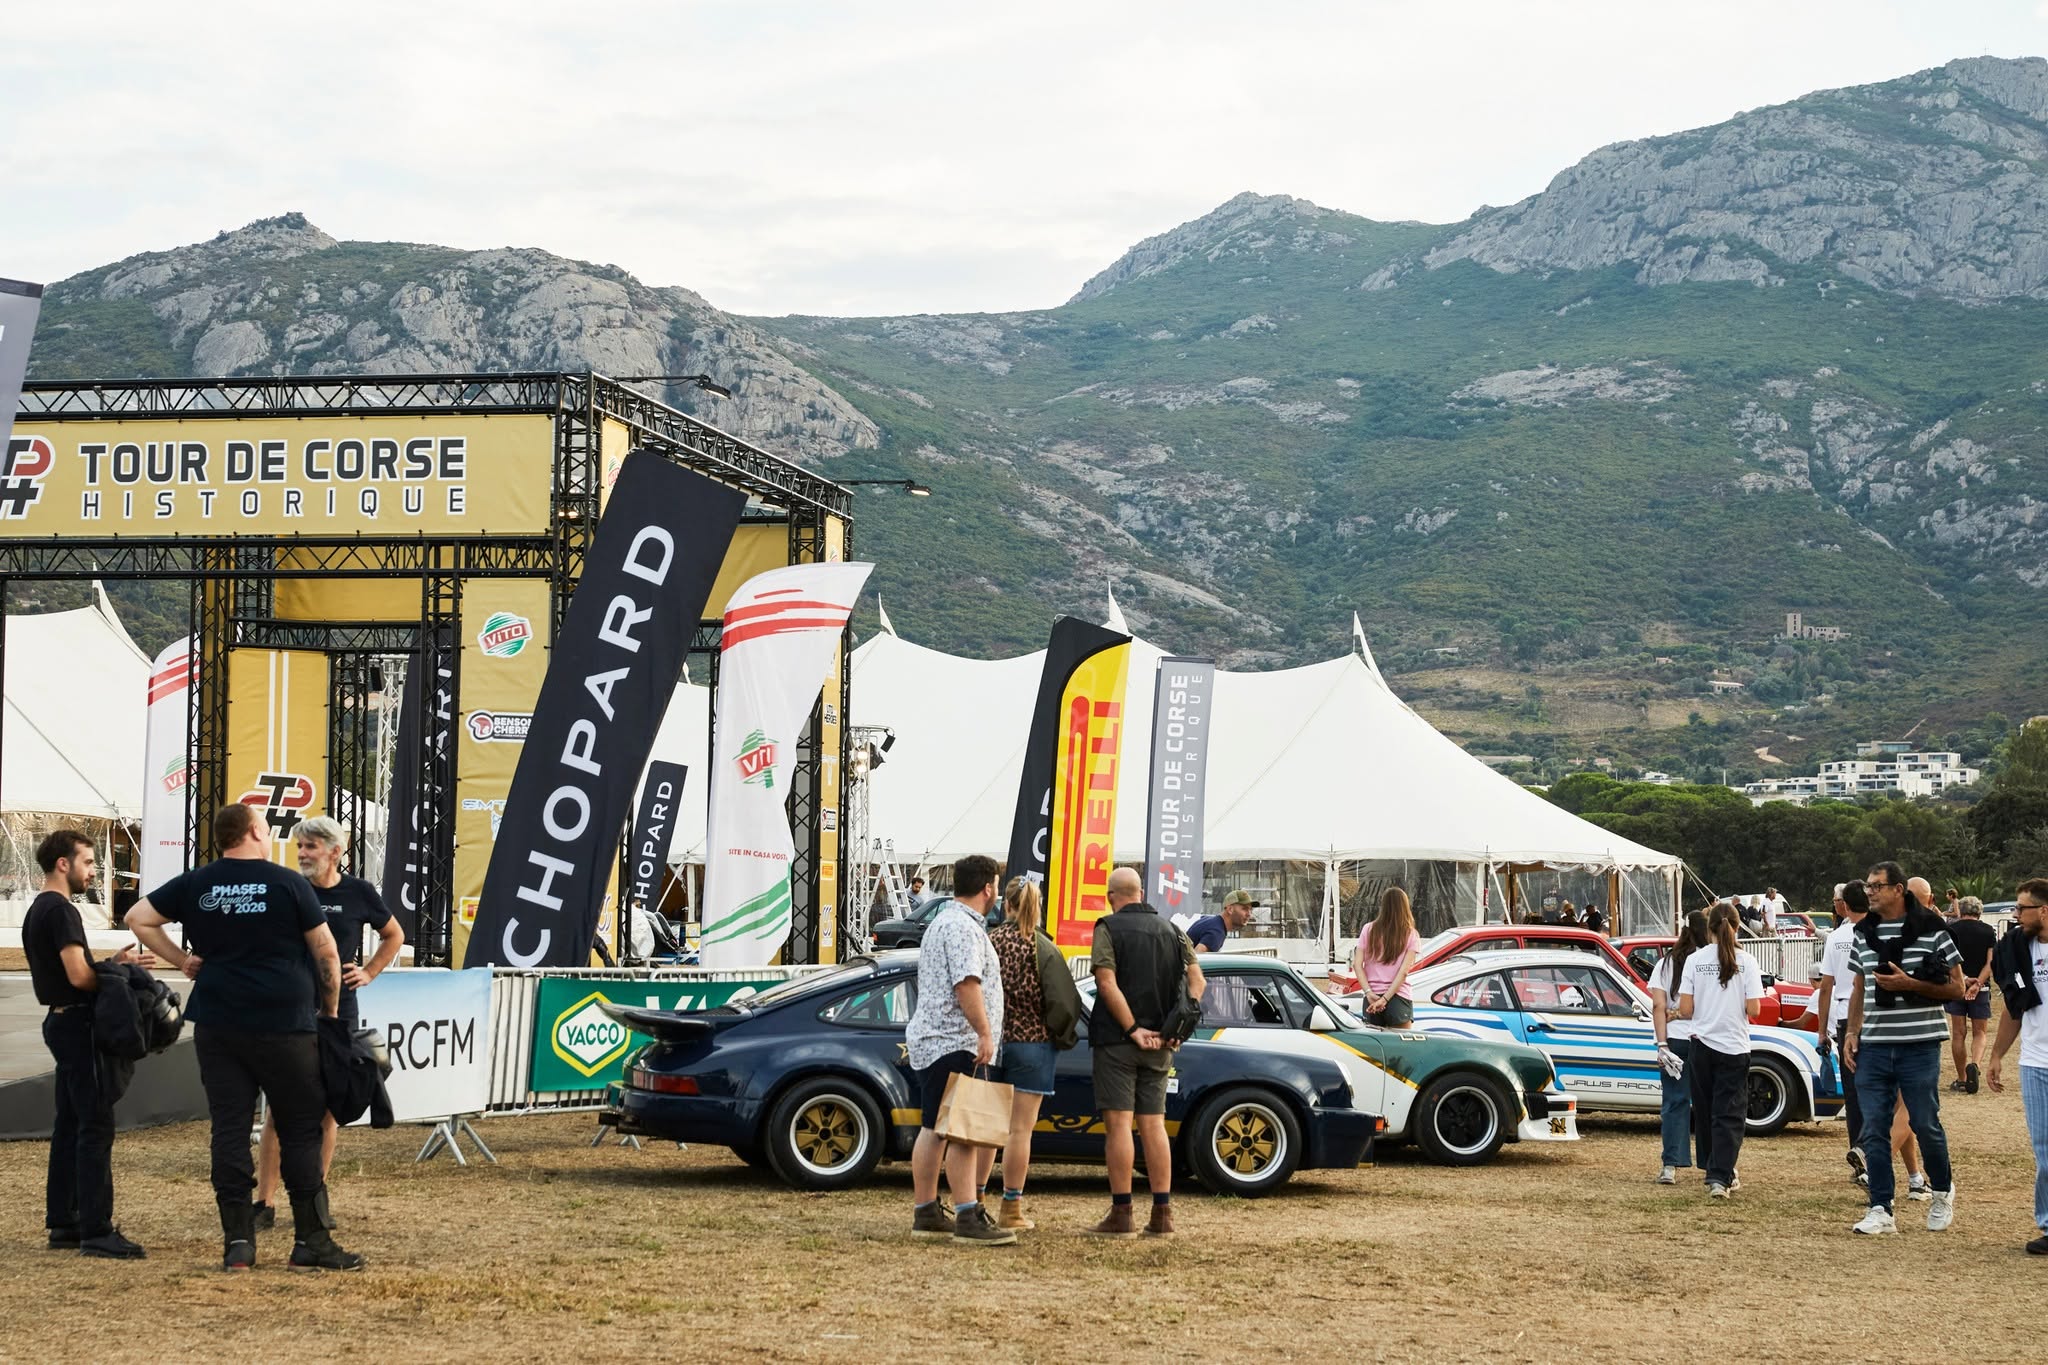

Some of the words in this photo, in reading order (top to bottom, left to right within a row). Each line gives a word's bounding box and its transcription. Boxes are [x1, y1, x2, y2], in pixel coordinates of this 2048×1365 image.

[80, 441, 208, 484] TOUR
[226, 440, 286, 483] DE
[304, 438, 466, 480] CORSE
[83, 487, 466, 517] HISTORIQUE
[494, 726, 530, 737] CHERR
[1166, 674, 1189, 753] CORSE
[502, 524, 675, 968] CHOPARD
[1163, 760, 1183, 791] DE
[1180, 674, 1204, 859] HISTORIQUE
[634, 781, 673, 911] HOPARD
[1160, 796, 1181, 861] TOUR
[212, 884, 267, 897] PHASES
[235, 903, 266, 914] 2026
[387, 1017, 475, 1071] RCFM
[566, 1024, 620, 1046] YACCO
[1565, 1080, 1612, 1088] JAWS
[1617, 1082, 1664, 1090] RACIN
